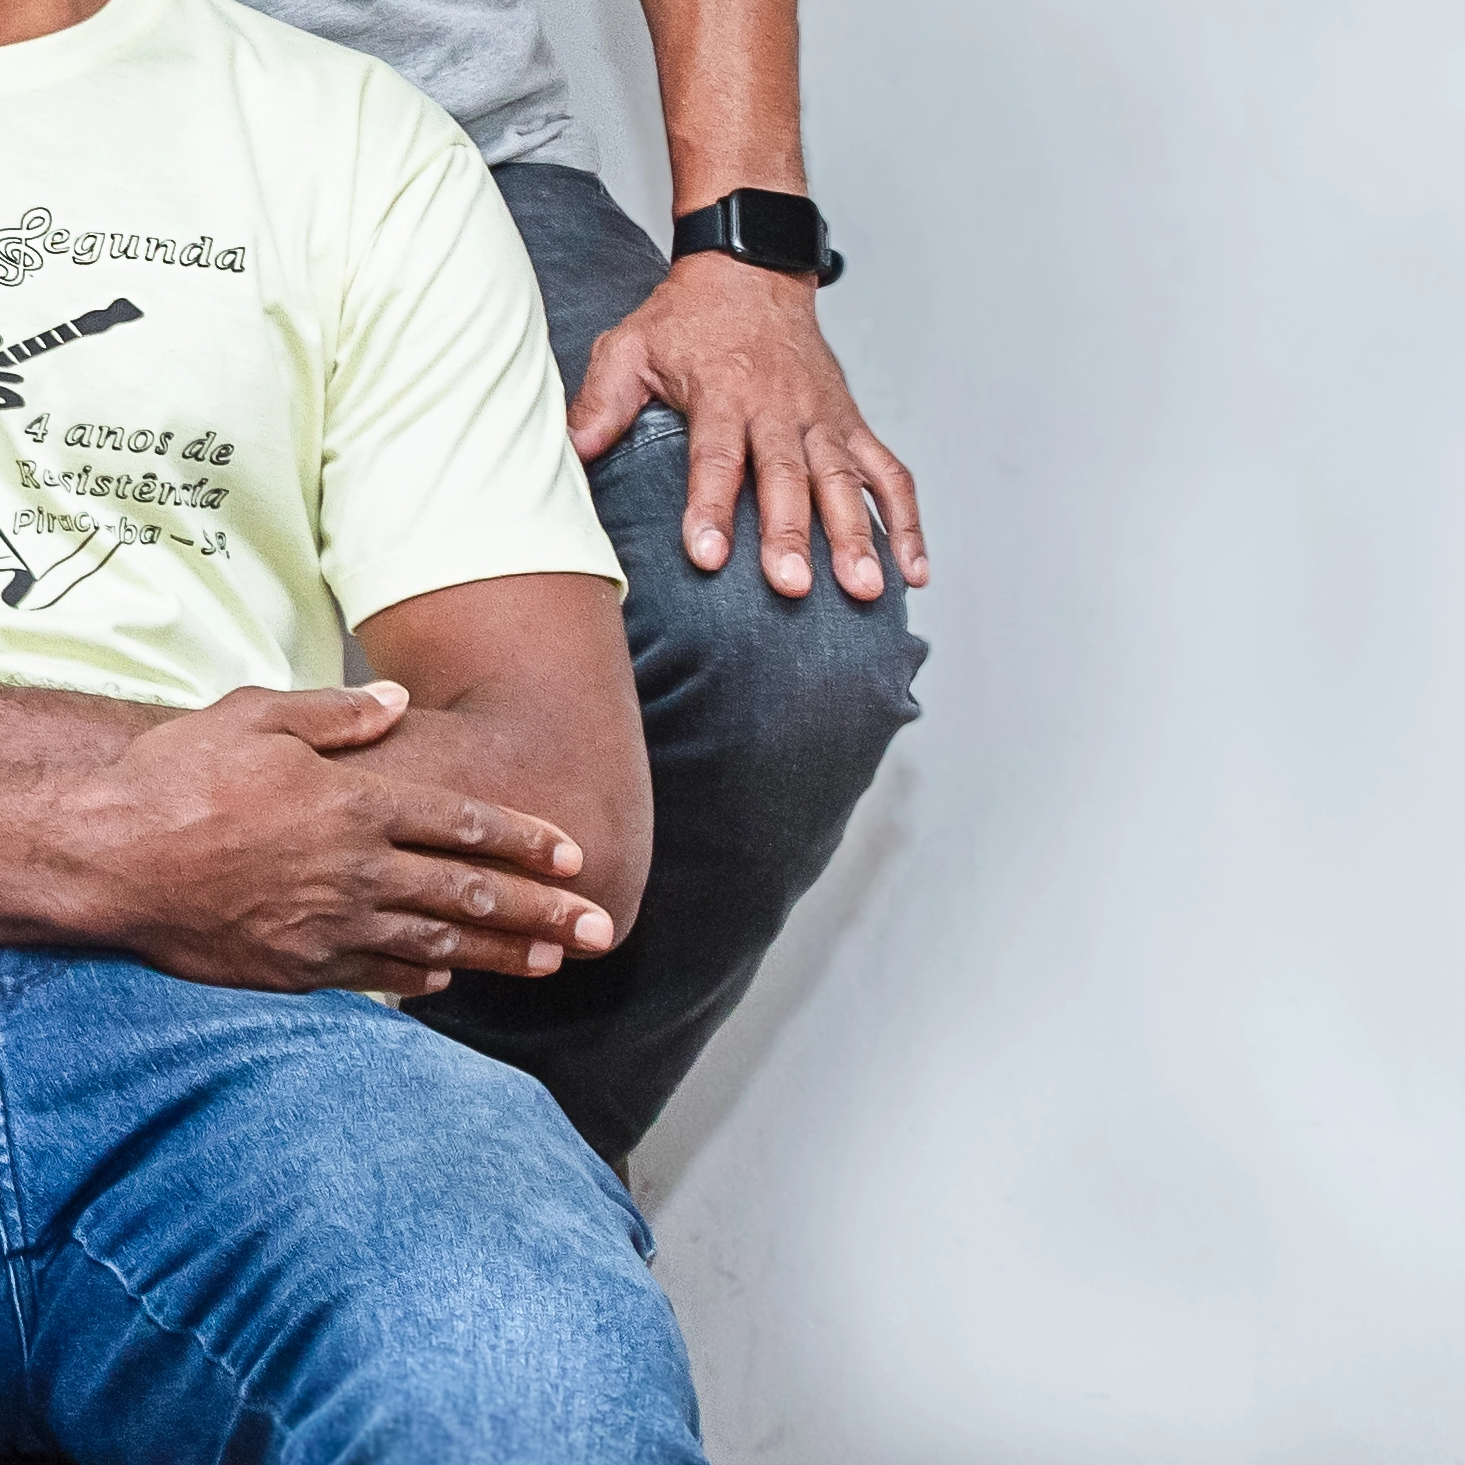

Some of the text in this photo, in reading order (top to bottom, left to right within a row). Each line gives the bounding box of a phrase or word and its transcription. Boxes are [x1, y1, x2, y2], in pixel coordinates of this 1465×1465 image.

[24, 413, 235, 465] 4 anos de
